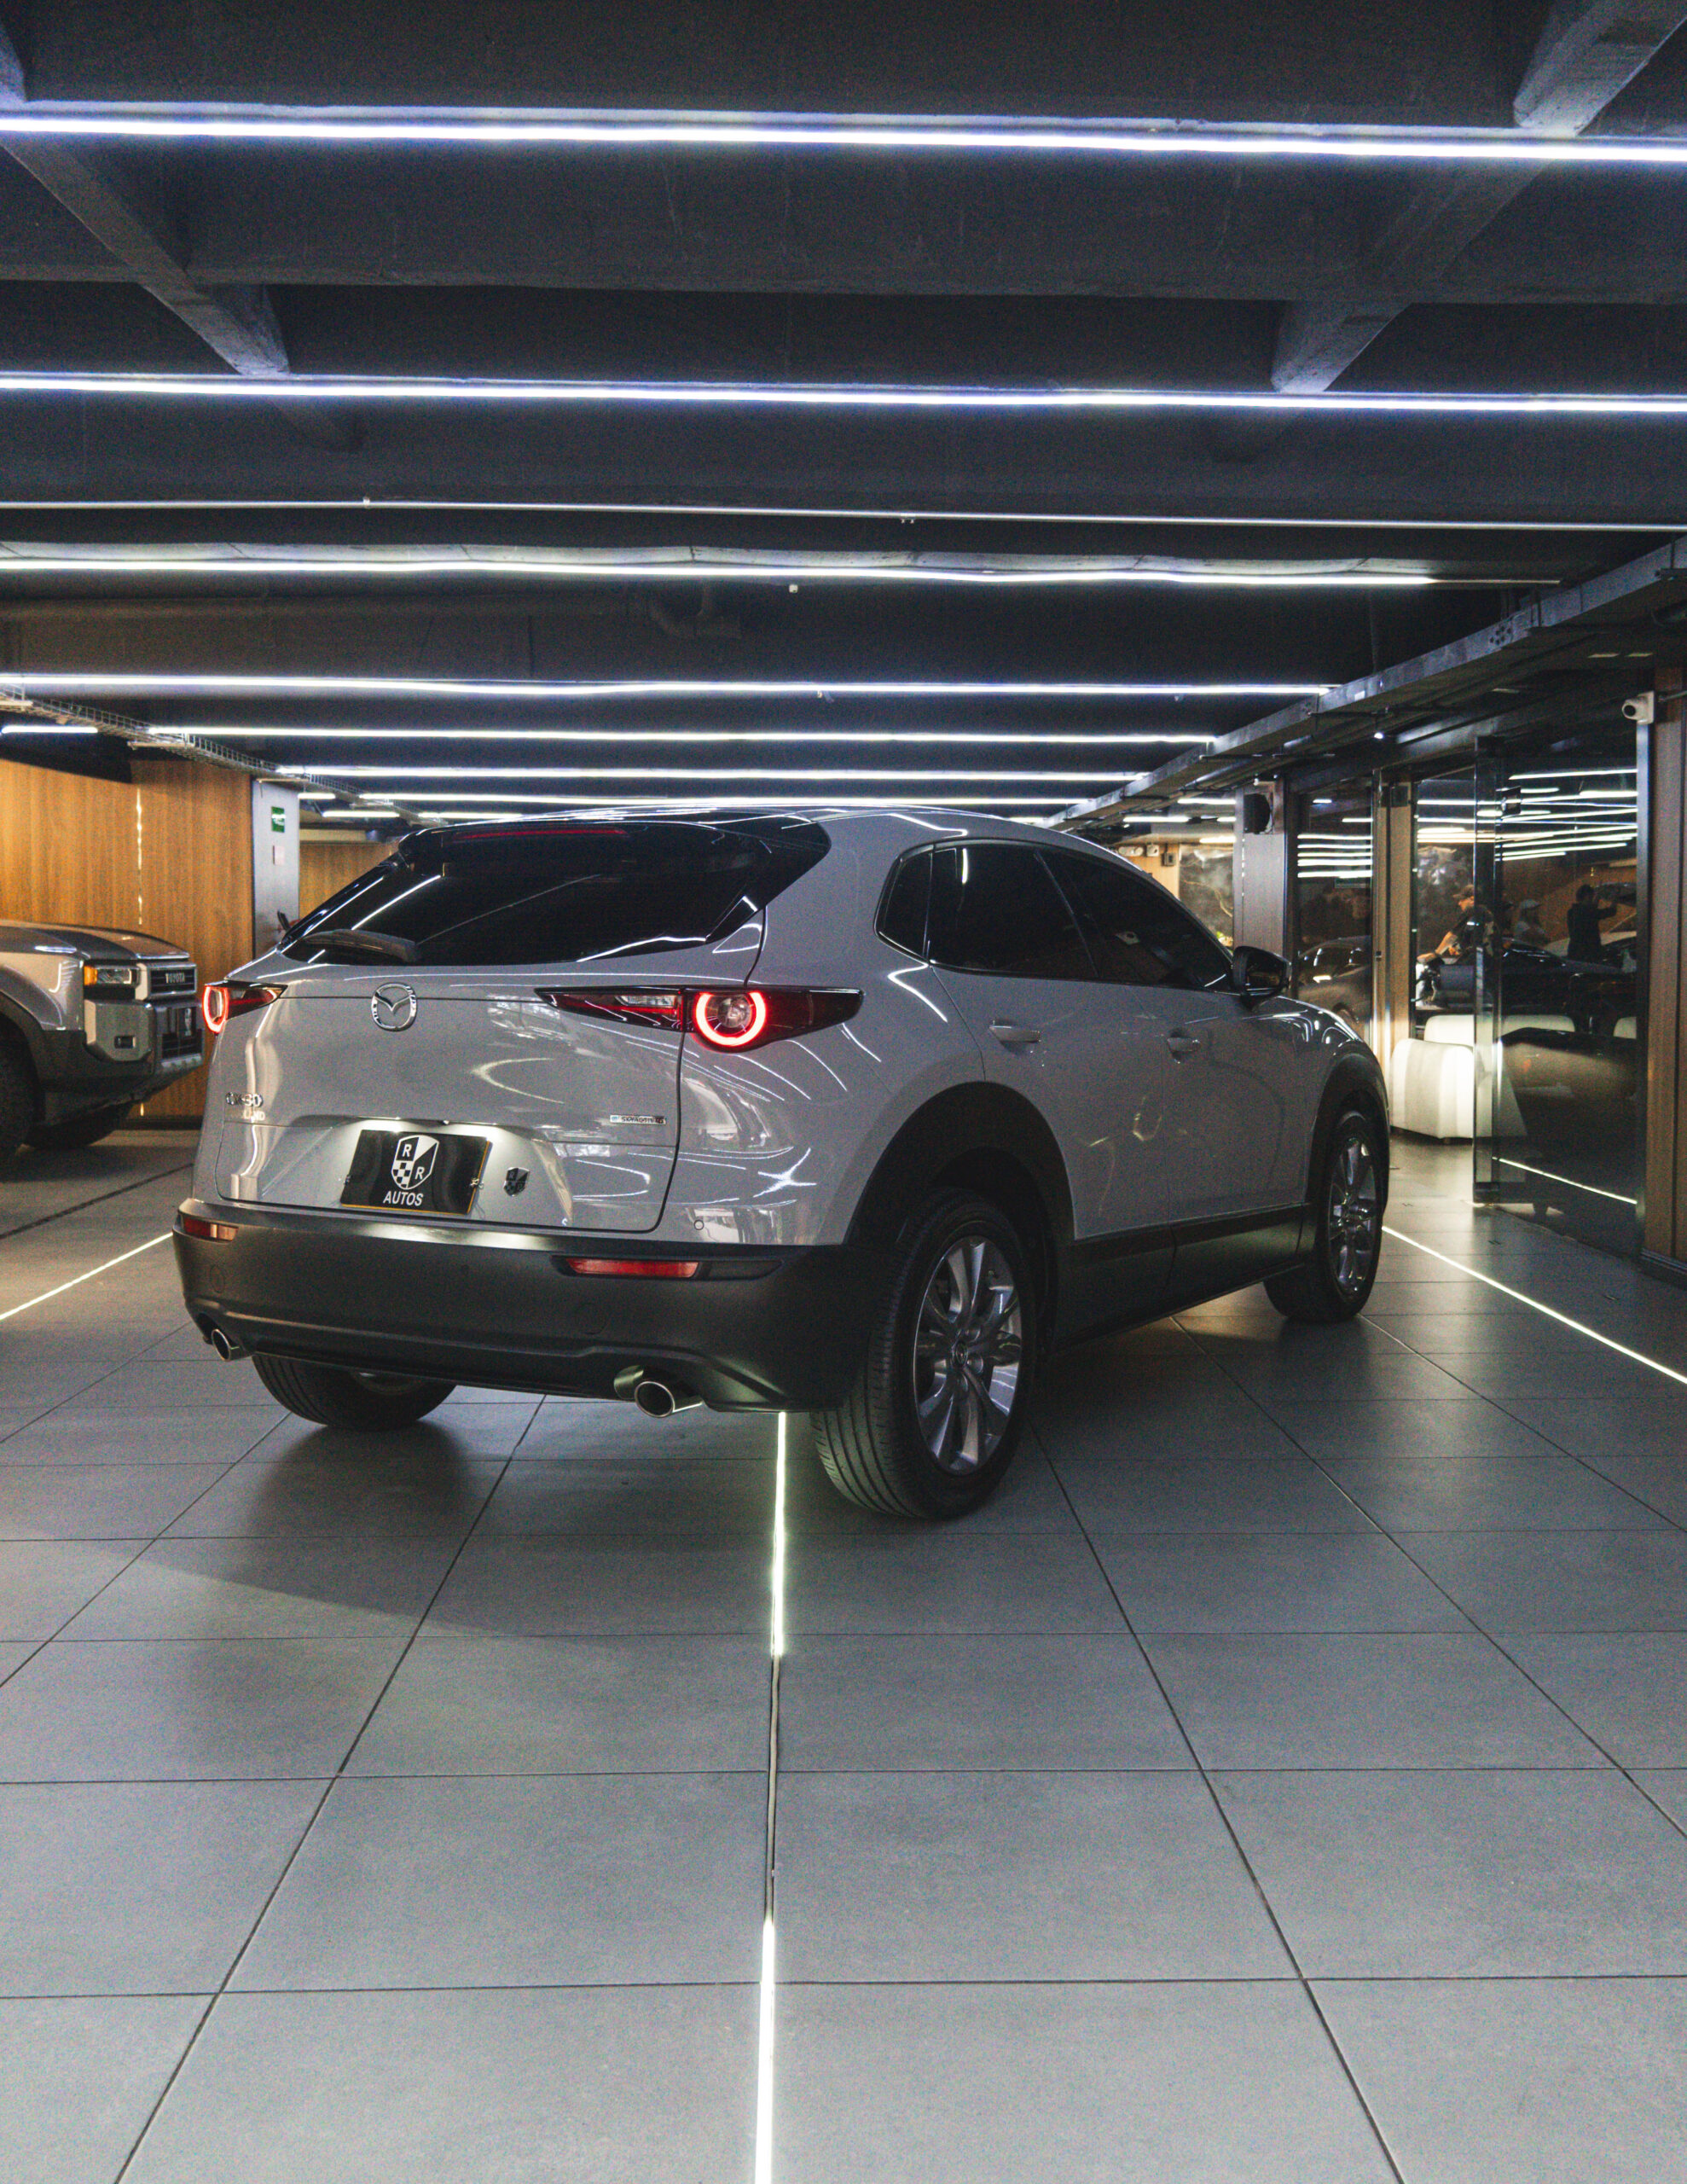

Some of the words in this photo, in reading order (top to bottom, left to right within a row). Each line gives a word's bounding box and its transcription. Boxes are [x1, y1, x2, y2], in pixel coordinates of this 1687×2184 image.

[403, 1144, 412, 1157] R
[415, 1166, 425, 1180] R
[383, 1191, 424, 1206] AUTOS
